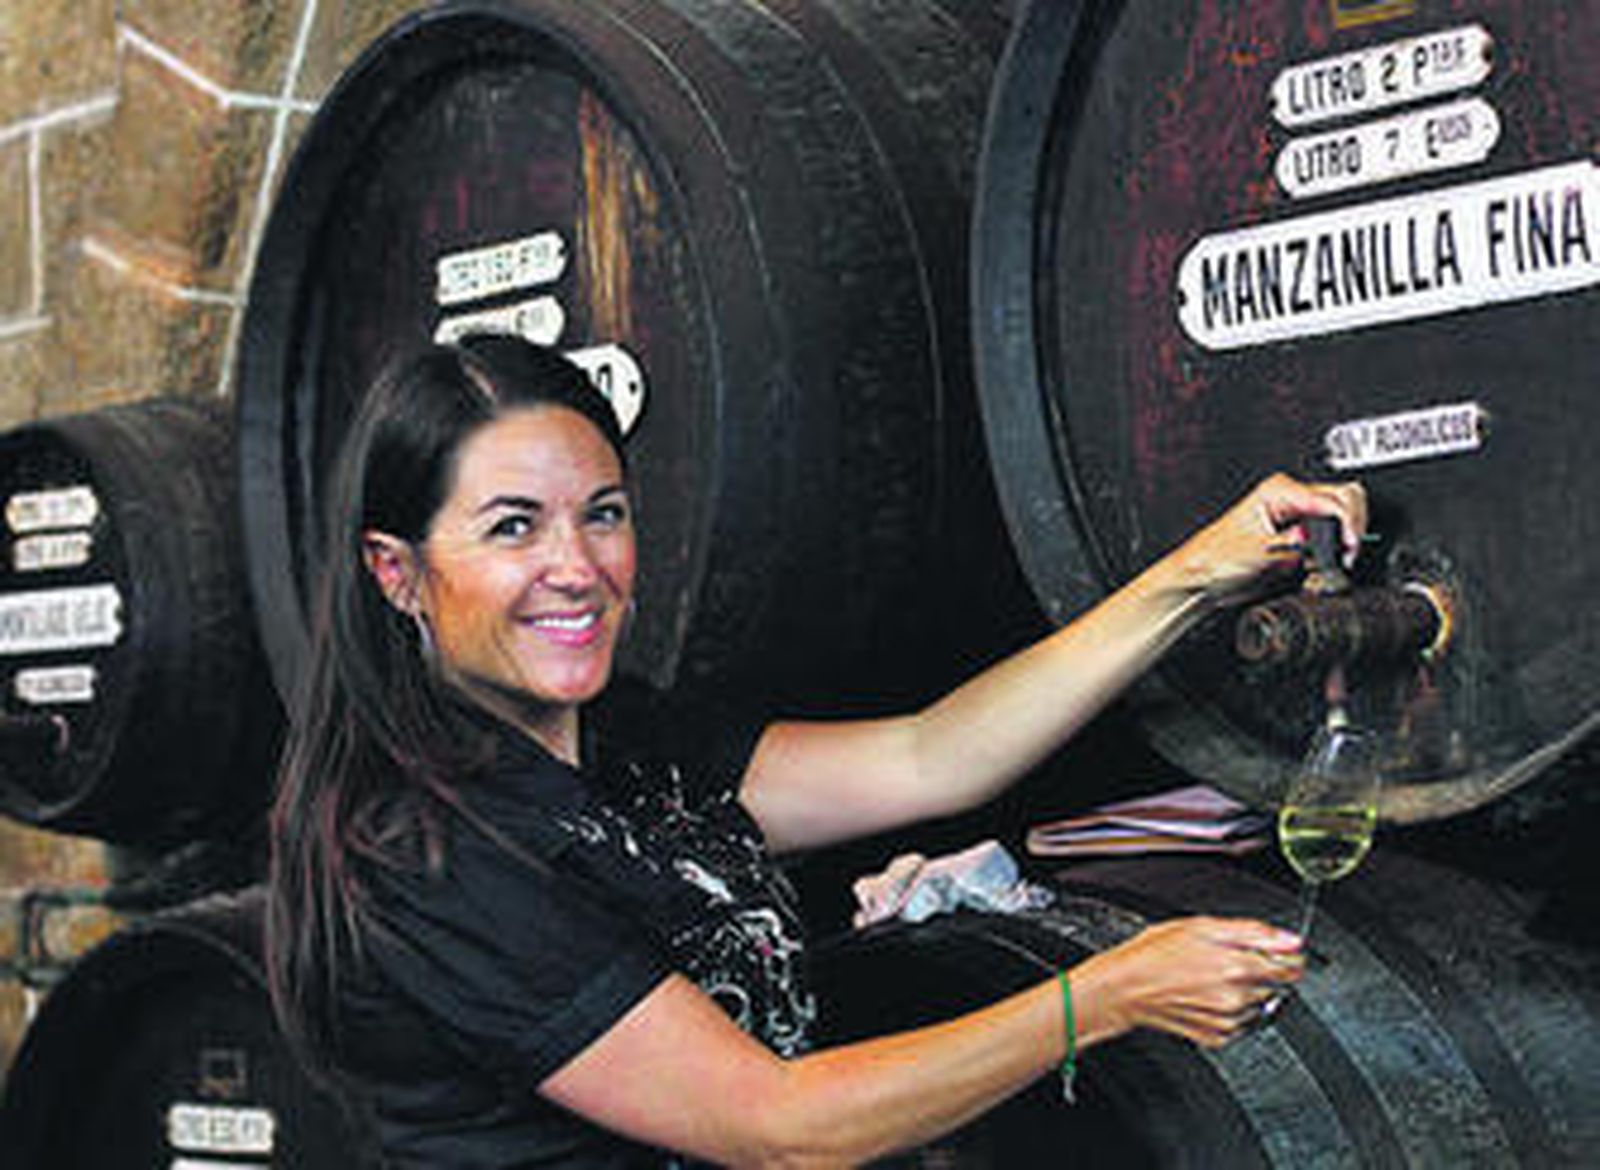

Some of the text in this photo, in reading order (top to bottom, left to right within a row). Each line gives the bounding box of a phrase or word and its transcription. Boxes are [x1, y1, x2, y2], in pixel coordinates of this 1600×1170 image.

[1288, 61, 1365, 115] LITRO
[1380, 54, 1400, 93] 2
[1293, 137, 1362, 185] LITRO
[1387, 129, 1400, 161] 7
[1201, 187, 1592, 329] MANZANILLA FINA
